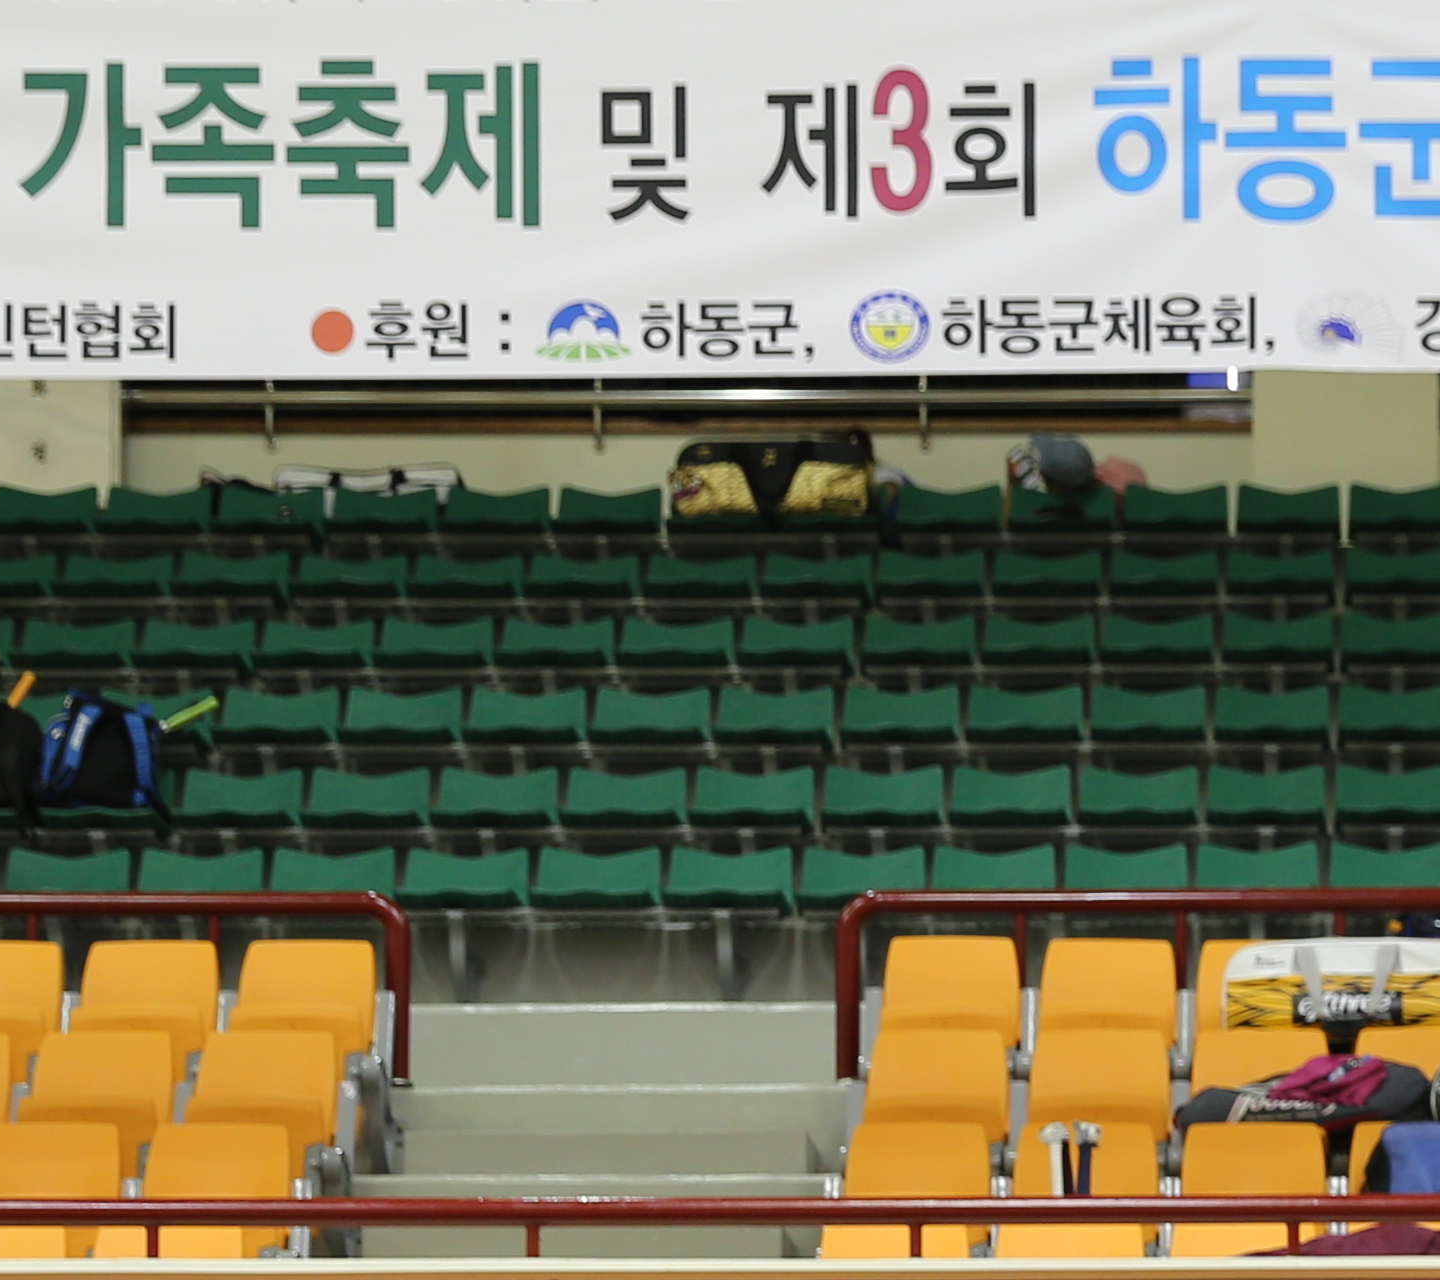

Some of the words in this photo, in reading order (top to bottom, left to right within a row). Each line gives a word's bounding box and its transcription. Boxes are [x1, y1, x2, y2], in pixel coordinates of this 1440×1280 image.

[20, 58, 542, 231] 가족축제
[600, 84, 692, 223] 및
[761, 67, 1038, 221] 제3회
[365, 302, 471, 362] 후원
[641, 302, 816, 360] 하동군,
[942, 296, 1276, 357] 하동군체육회,
